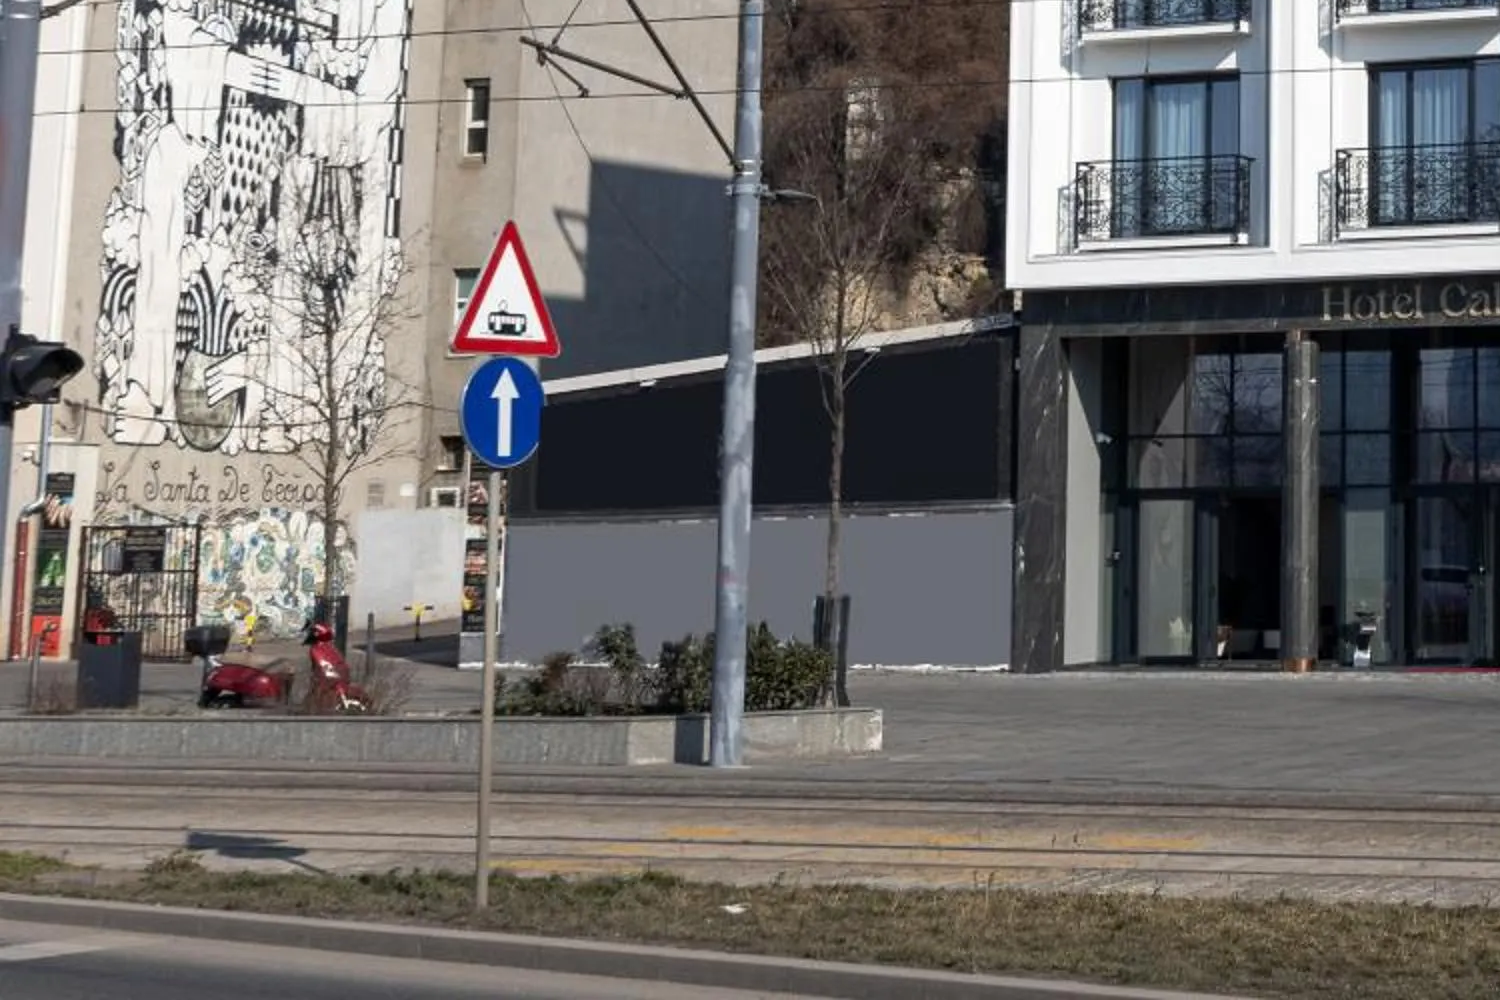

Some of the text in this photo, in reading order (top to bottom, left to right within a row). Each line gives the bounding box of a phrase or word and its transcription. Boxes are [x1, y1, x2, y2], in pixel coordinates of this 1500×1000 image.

[1320, 284, 1424, 321] Hotel
[96, 459, 130, 503] La
[143, 459, 211, 502] Santa
[218, 464, 250, 501] De
